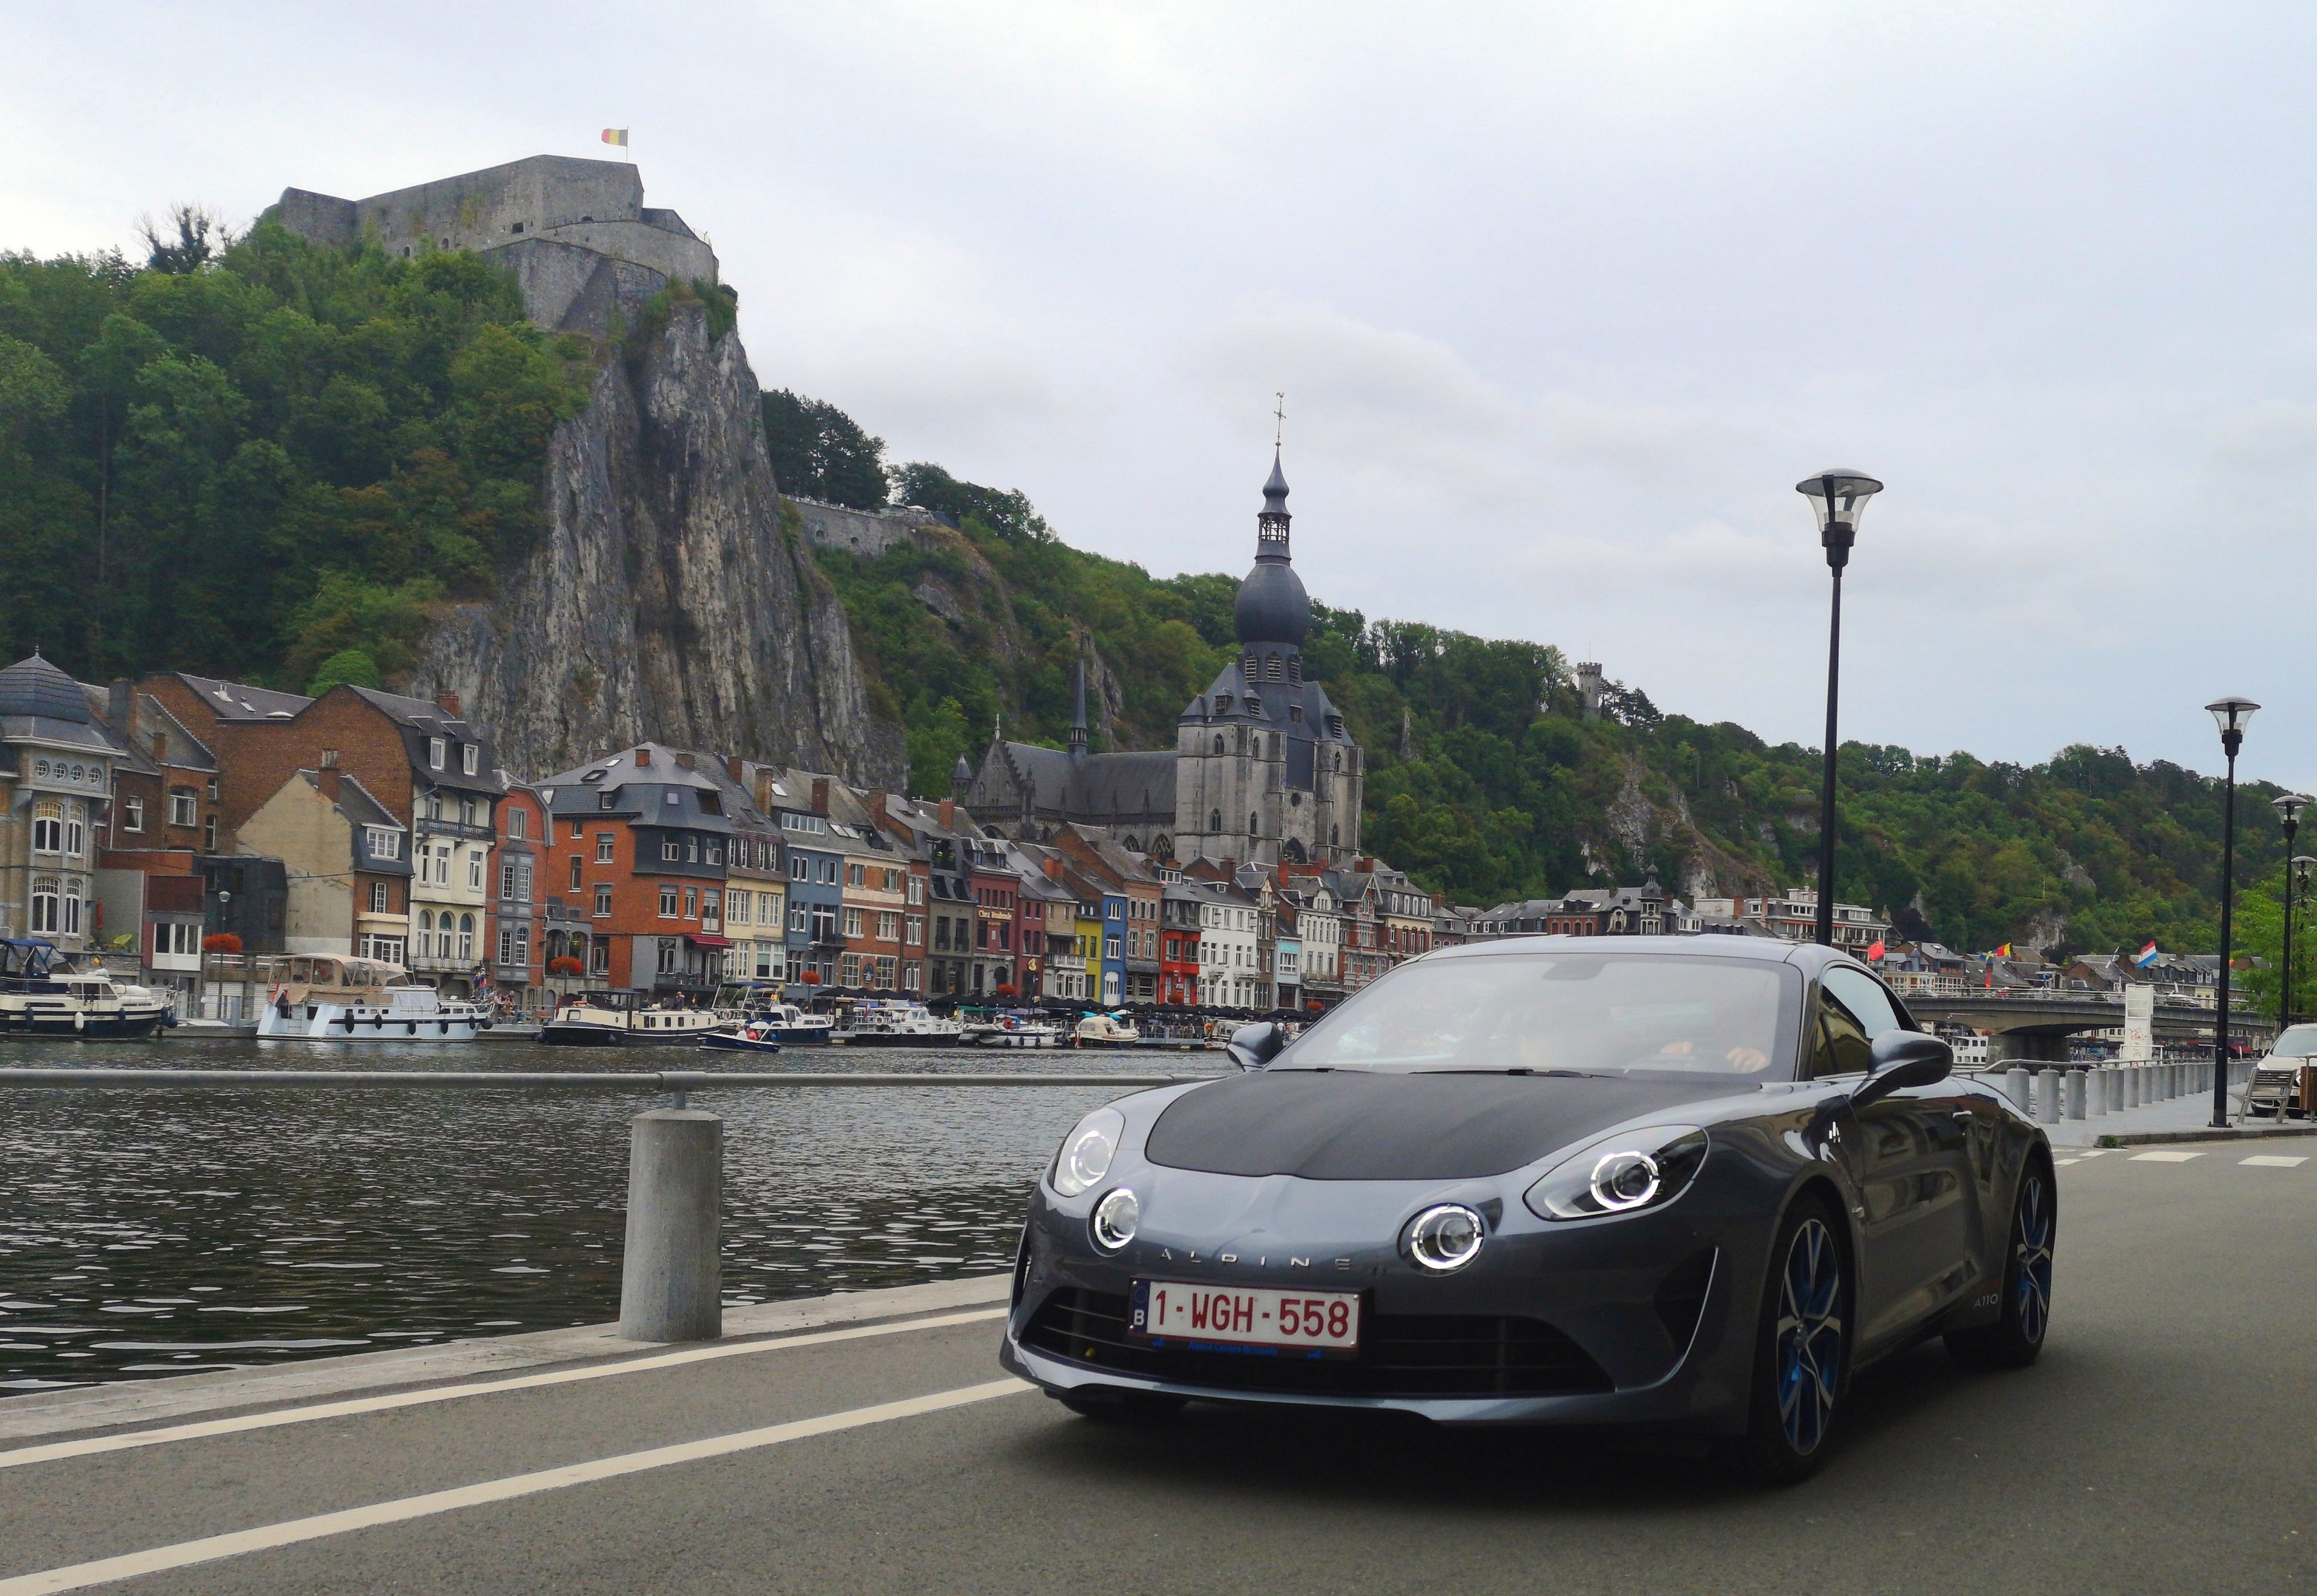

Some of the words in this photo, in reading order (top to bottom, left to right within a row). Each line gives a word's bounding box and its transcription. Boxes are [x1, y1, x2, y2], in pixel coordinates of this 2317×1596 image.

[1161, 1248, 1351, 1271] ALPINE
[1973, 1294, 1999, 1308] A110
[1133, 1309, 1144, 1326] B
[1188, 1341, 1212, 1352] Alpine
